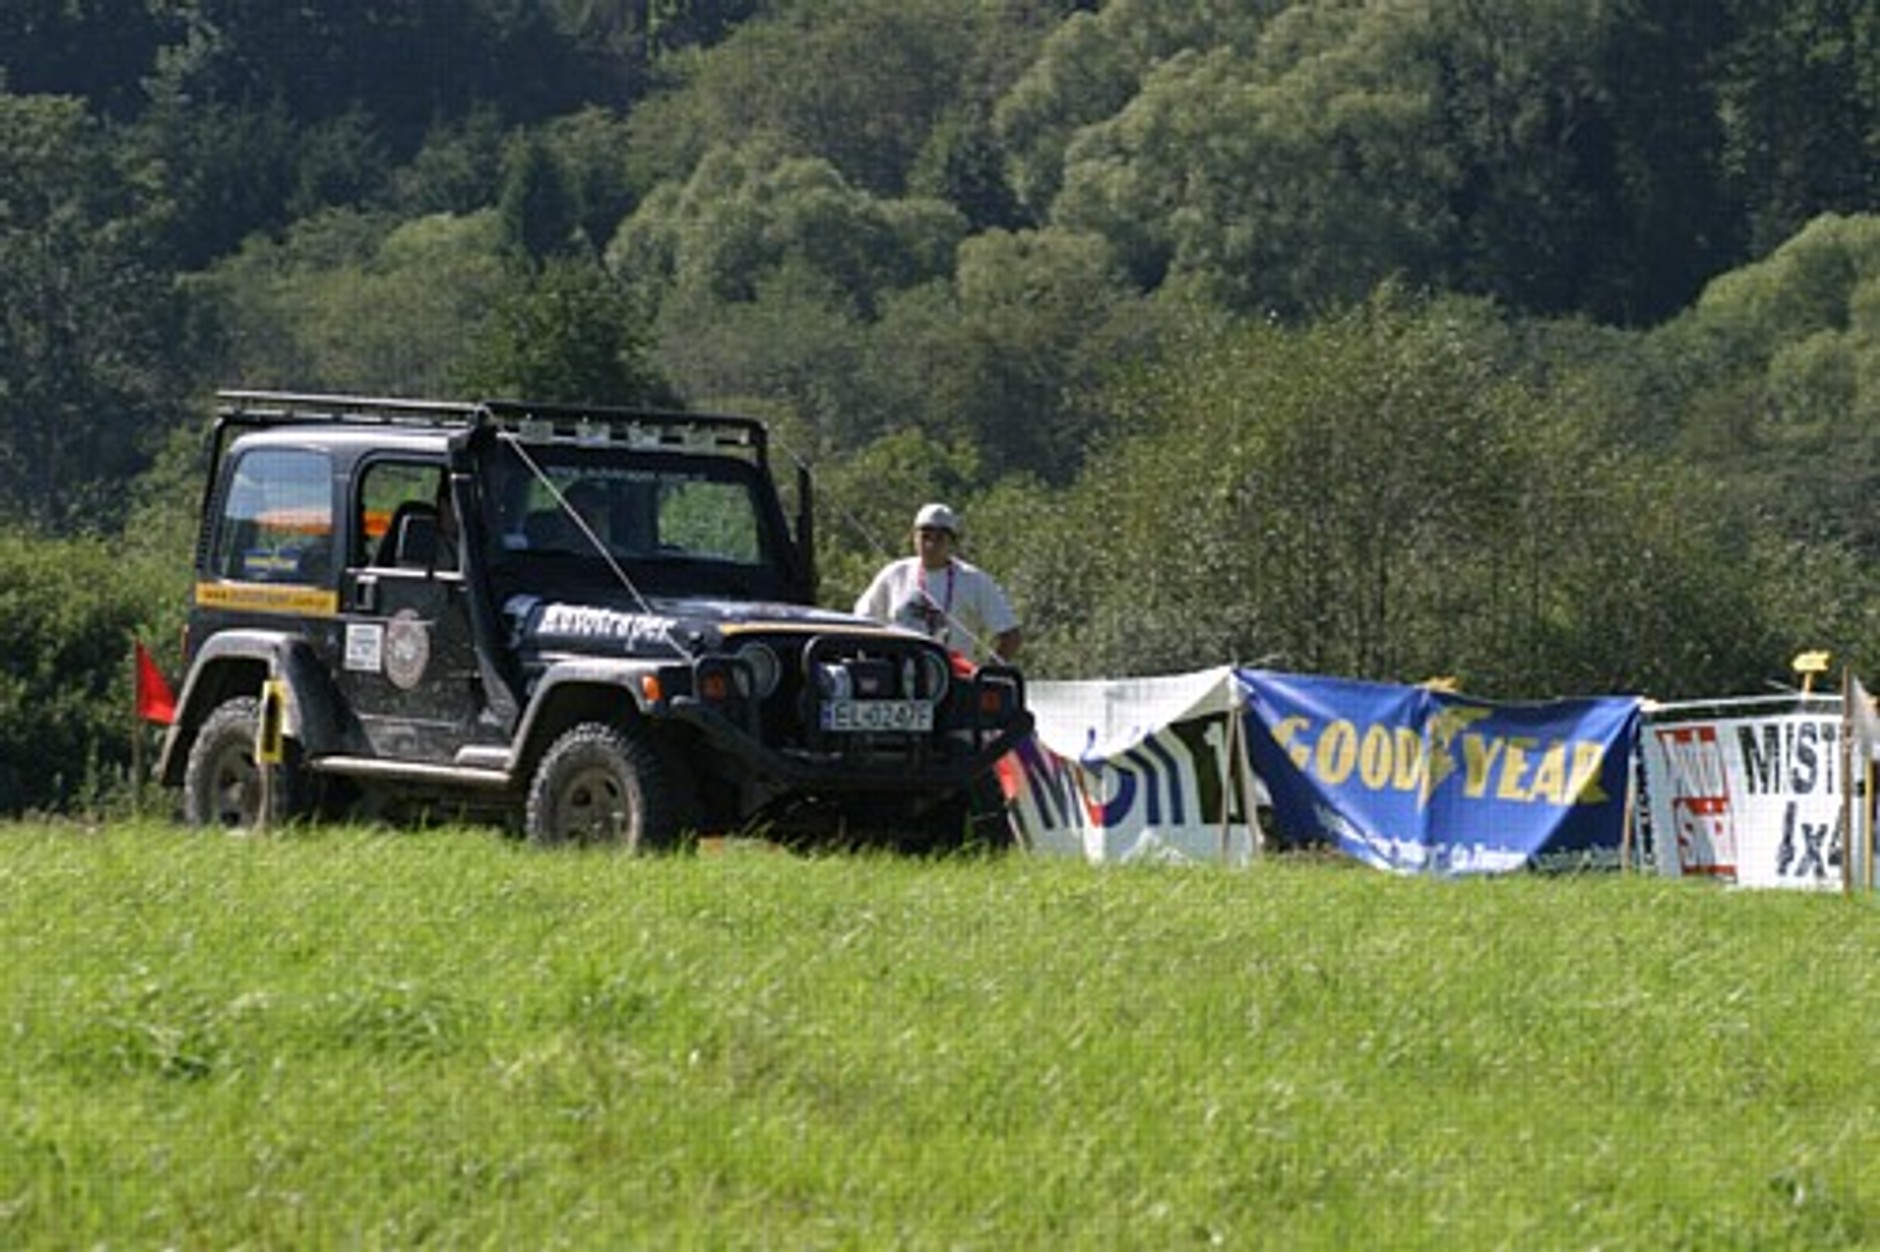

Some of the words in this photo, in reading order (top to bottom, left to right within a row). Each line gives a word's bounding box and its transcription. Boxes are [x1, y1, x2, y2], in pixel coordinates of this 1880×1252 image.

[1271, 715, 1425, 792] GOOD
[1463, 733, 1610, 805] YEAR
[1737, 722, 1844, 795] MIST
